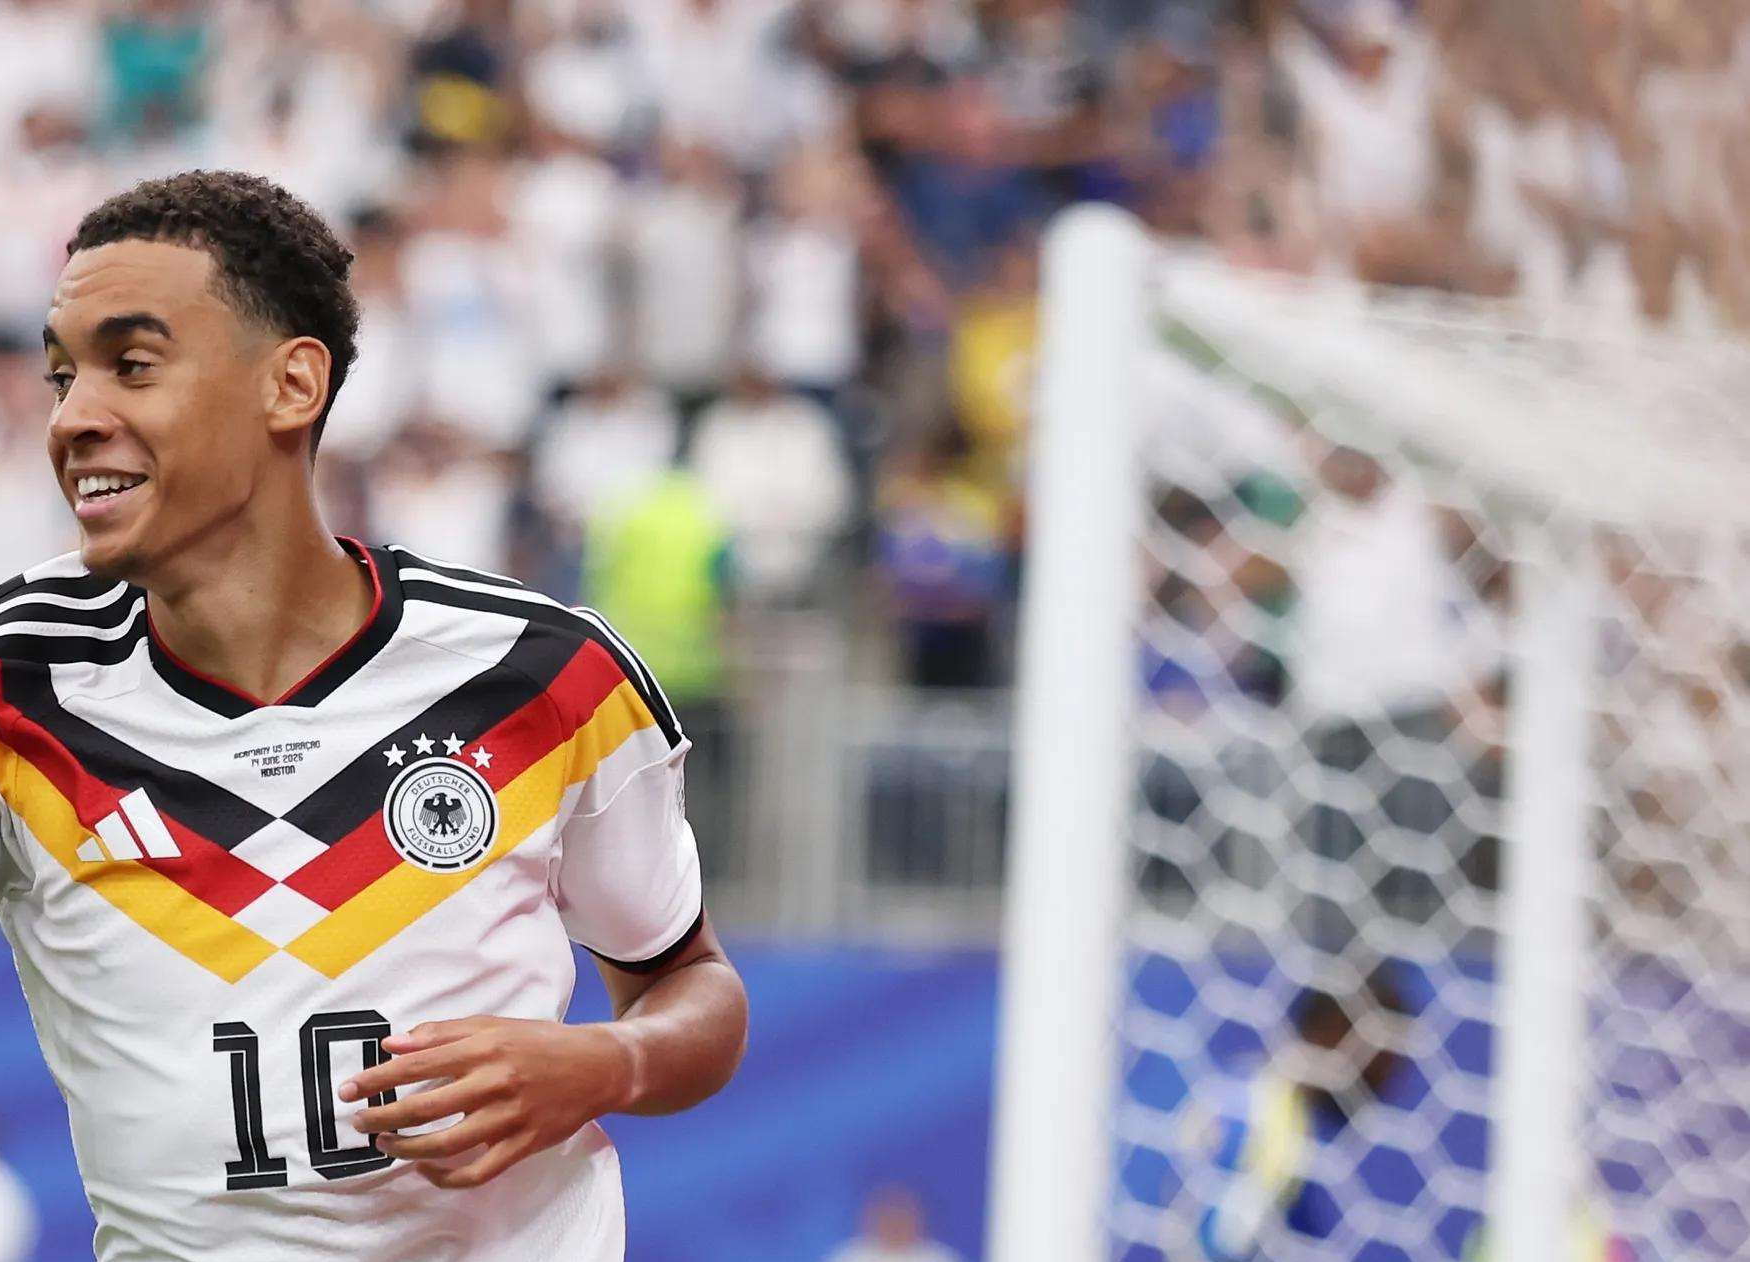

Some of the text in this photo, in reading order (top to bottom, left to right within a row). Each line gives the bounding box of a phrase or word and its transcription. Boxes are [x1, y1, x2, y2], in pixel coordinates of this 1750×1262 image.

[262, 756, 280, 765] JUNE
[283, 753, 303, 763] 2026
[261, 765, 295, 777] HOUSTON
[411, 776, 470, 795] DEUTSCHER
[408, 827, 480, 854] FUSSBALL-BUND
[212, 1009, 398, 1191] 10
